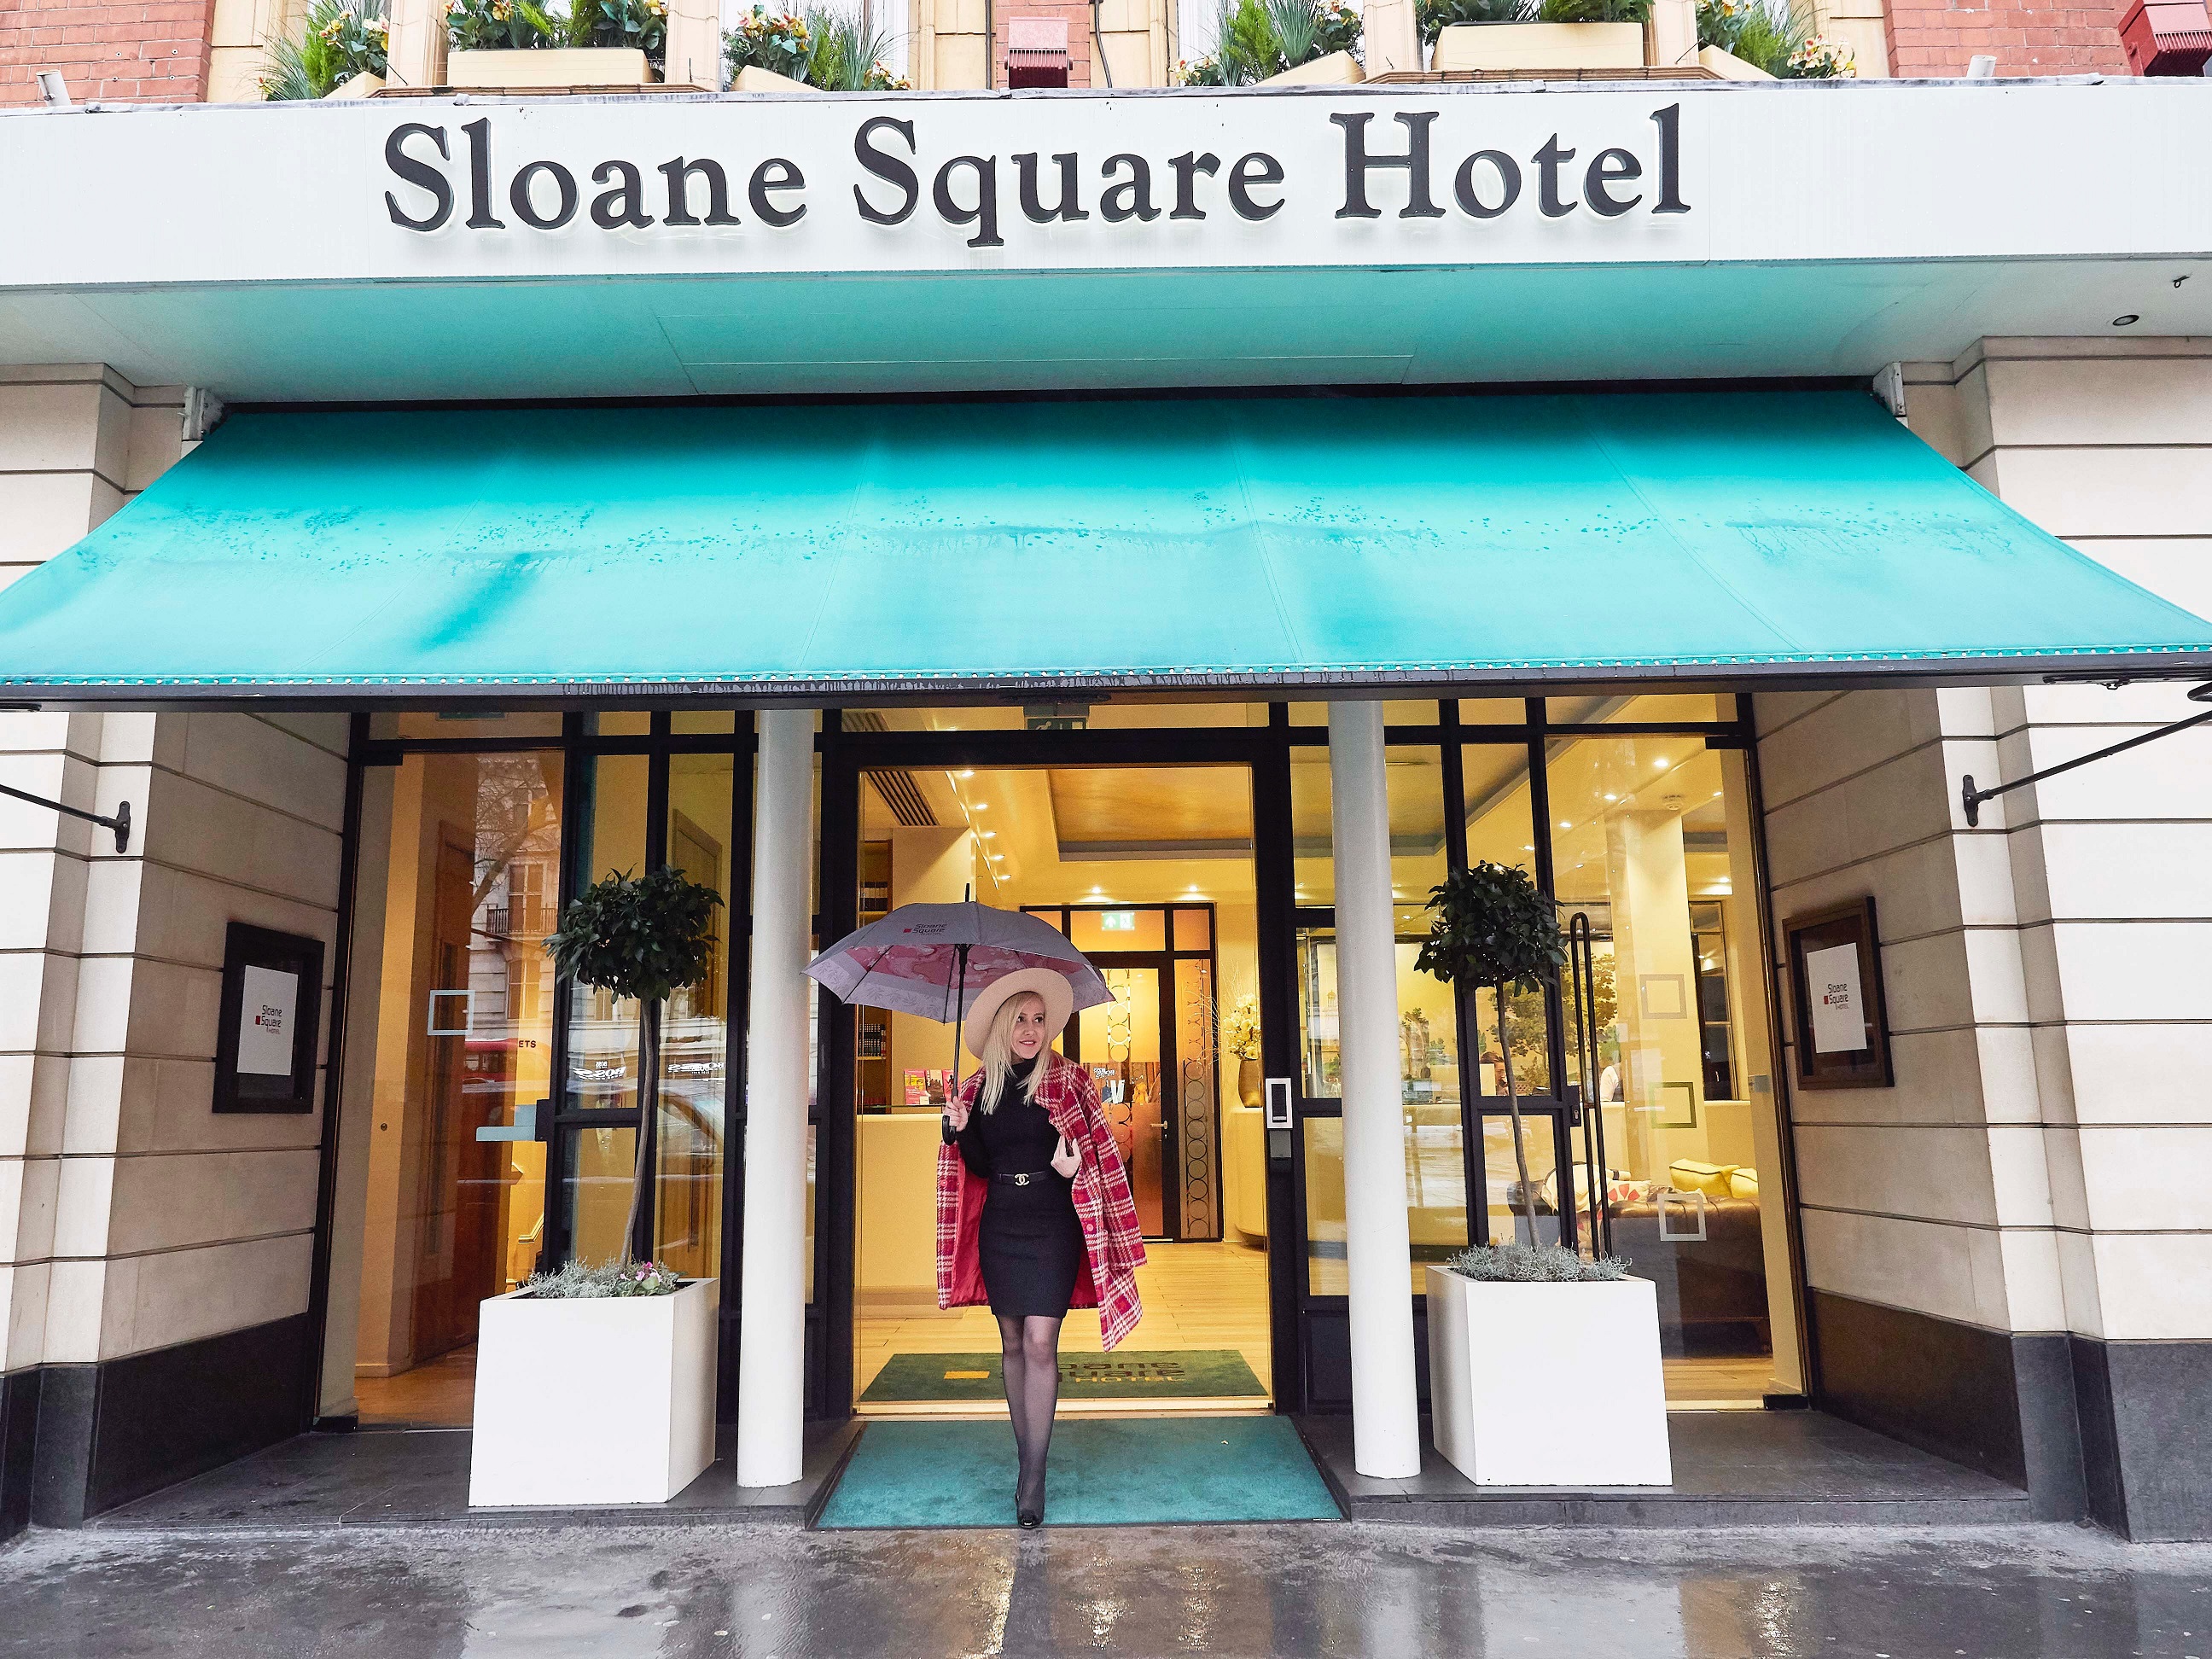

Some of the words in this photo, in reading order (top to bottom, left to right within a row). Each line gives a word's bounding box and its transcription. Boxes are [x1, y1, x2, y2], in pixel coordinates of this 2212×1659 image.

[383, 116, 809, 232] Sloane
[853, 115, 1287, 248] Square
[1329, 102, 1692, 219] Hotel
[1827, 983, 1848, 993] Sloane
[261, 1004, 282, 1016] Sloane
[1829, 994, 1848, 1010] Square
[260, 1016, 282, 1033] Square
